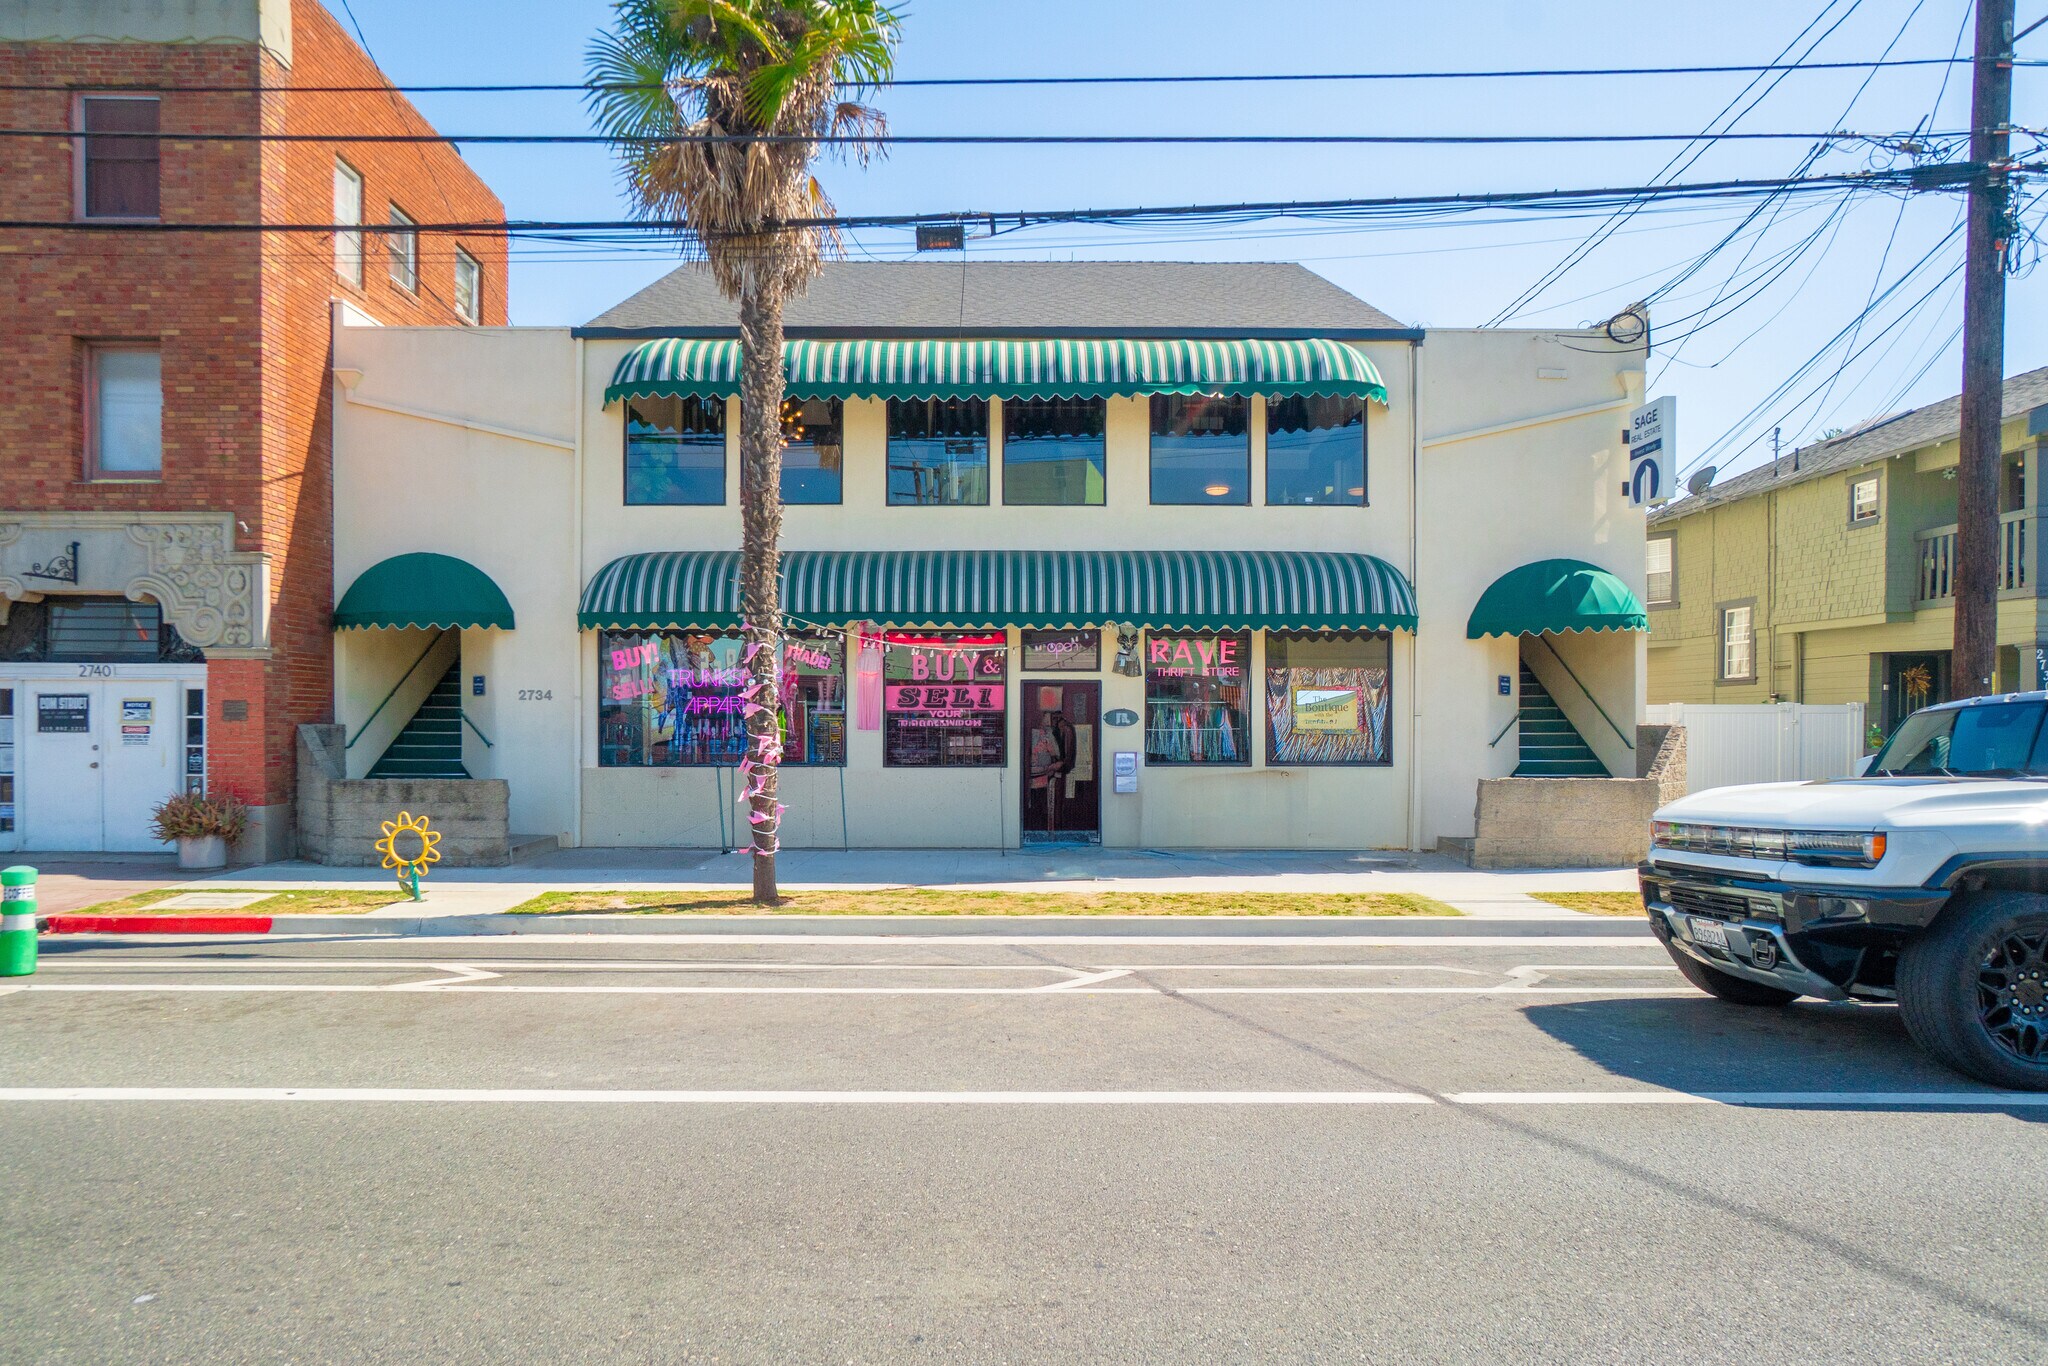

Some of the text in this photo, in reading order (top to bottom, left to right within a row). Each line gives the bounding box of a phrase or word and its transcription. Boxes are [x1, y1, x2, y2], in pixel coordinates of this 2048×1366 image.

[1635, 409, 1657, 430] SAGE
[1631, 425, 1661, 443] REAL ESTATE
[611, 642, 660, 671] BUY!
[786, 644, 832, 670] TRADE!
[1047, 643, 1079, 659] open
[1151, 639, 1238, 665] RAVE
[78, 664, 112, 677] 2740
[911, 653, 1001, 681] BUY &
[1156, 667, 1240, 677] THRIFT STORE
[518, 689, 553, 701] 2734
[612, 678, 656, 701] SELL!
[684, 696, 747, 715] APPAR
[929, 710, 962, 718] YOUR
[1305, 703, 1349, 714] Boutique
